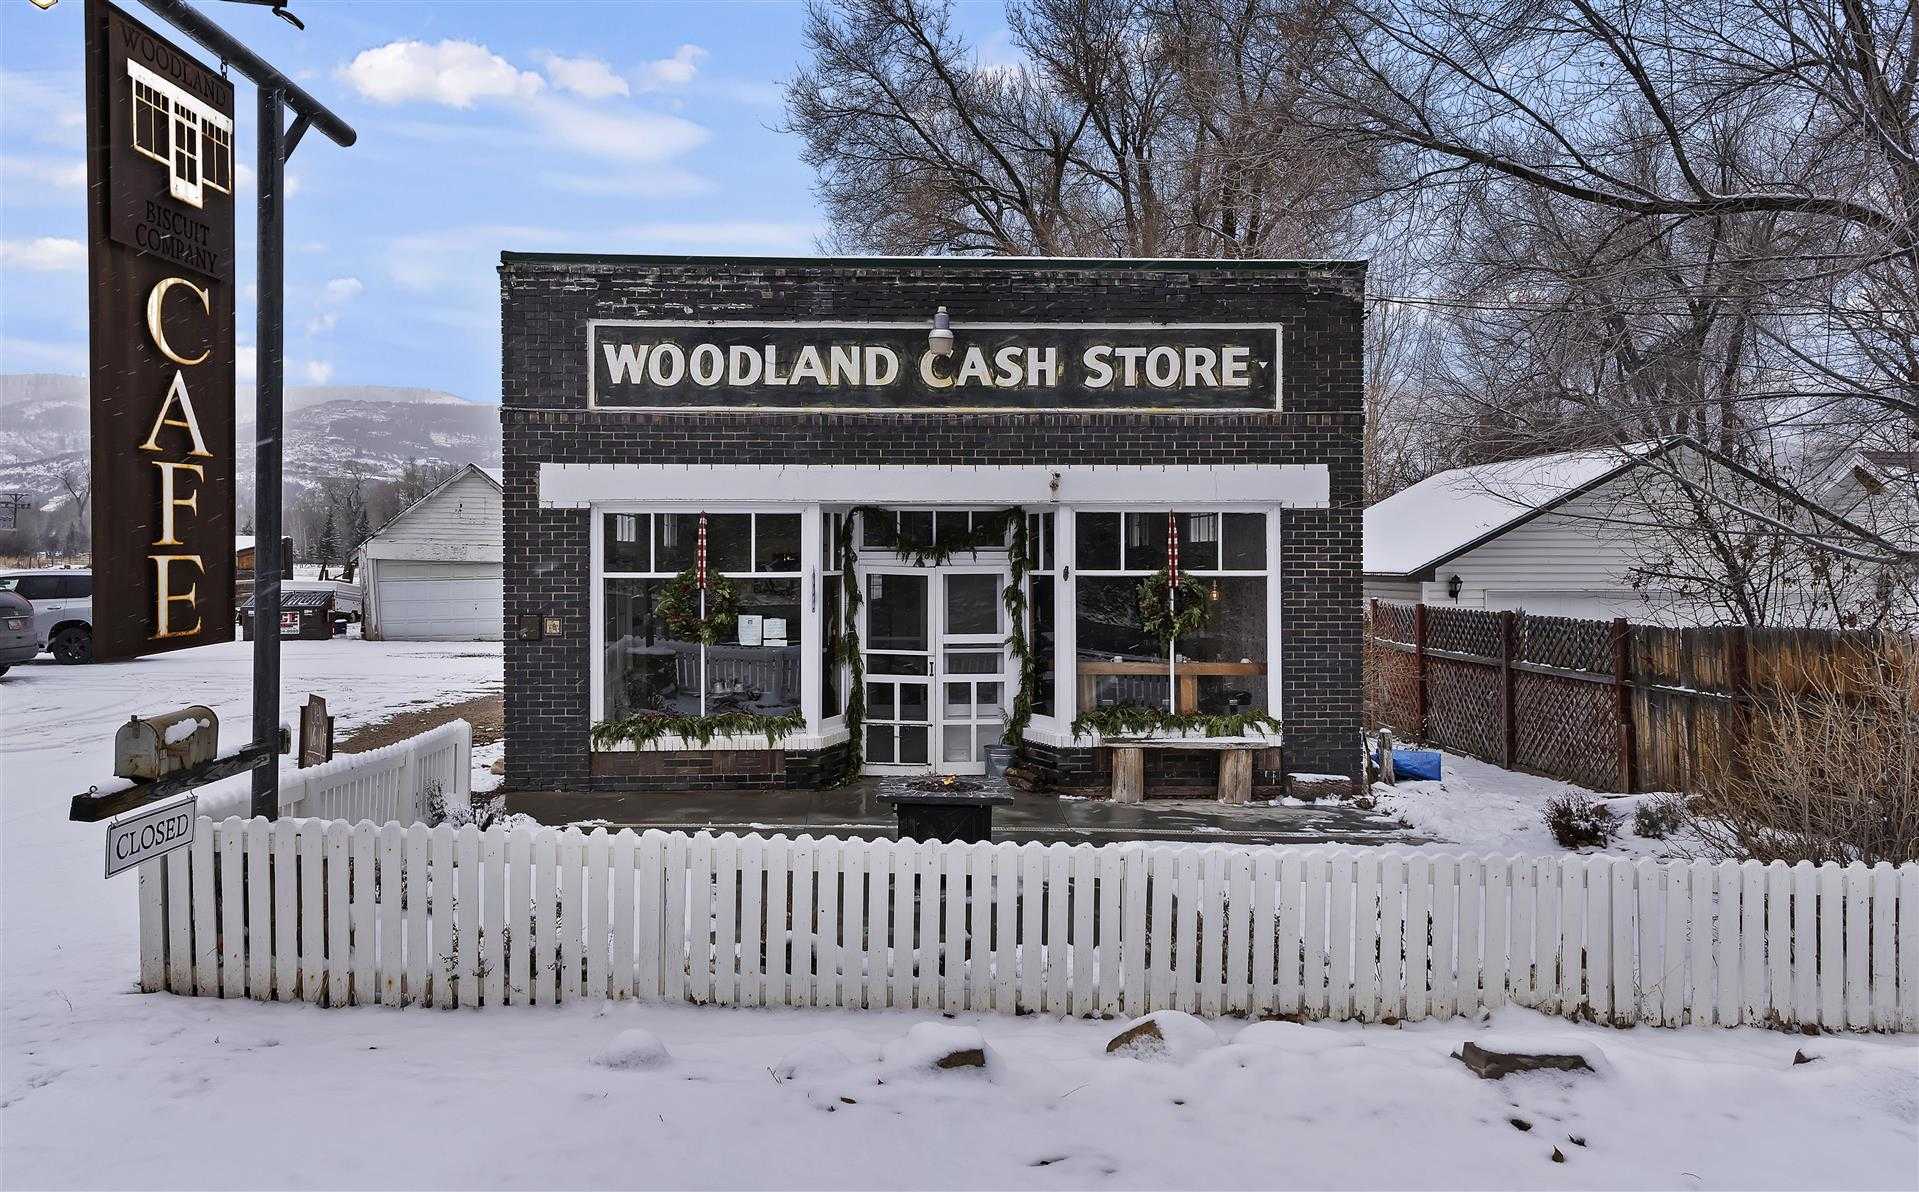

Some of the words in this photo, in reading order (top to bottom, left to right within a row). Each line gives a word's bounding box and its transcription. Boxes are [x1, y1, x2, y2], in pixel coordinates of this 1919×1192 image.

[119, 20, 226, 107] WOODLAND
[145, 200, 210, 246] BISCUIT
[135, 223, 218, 273] COMPANY
[602, 343, 899, 387] WOODLAND
[919, 345, 1056, 389] CASH
[1082, 345, 1250, 388] STORE
[139, 276, 214, 641] CAFE
[116, 814, 189, 860] CLOSED
